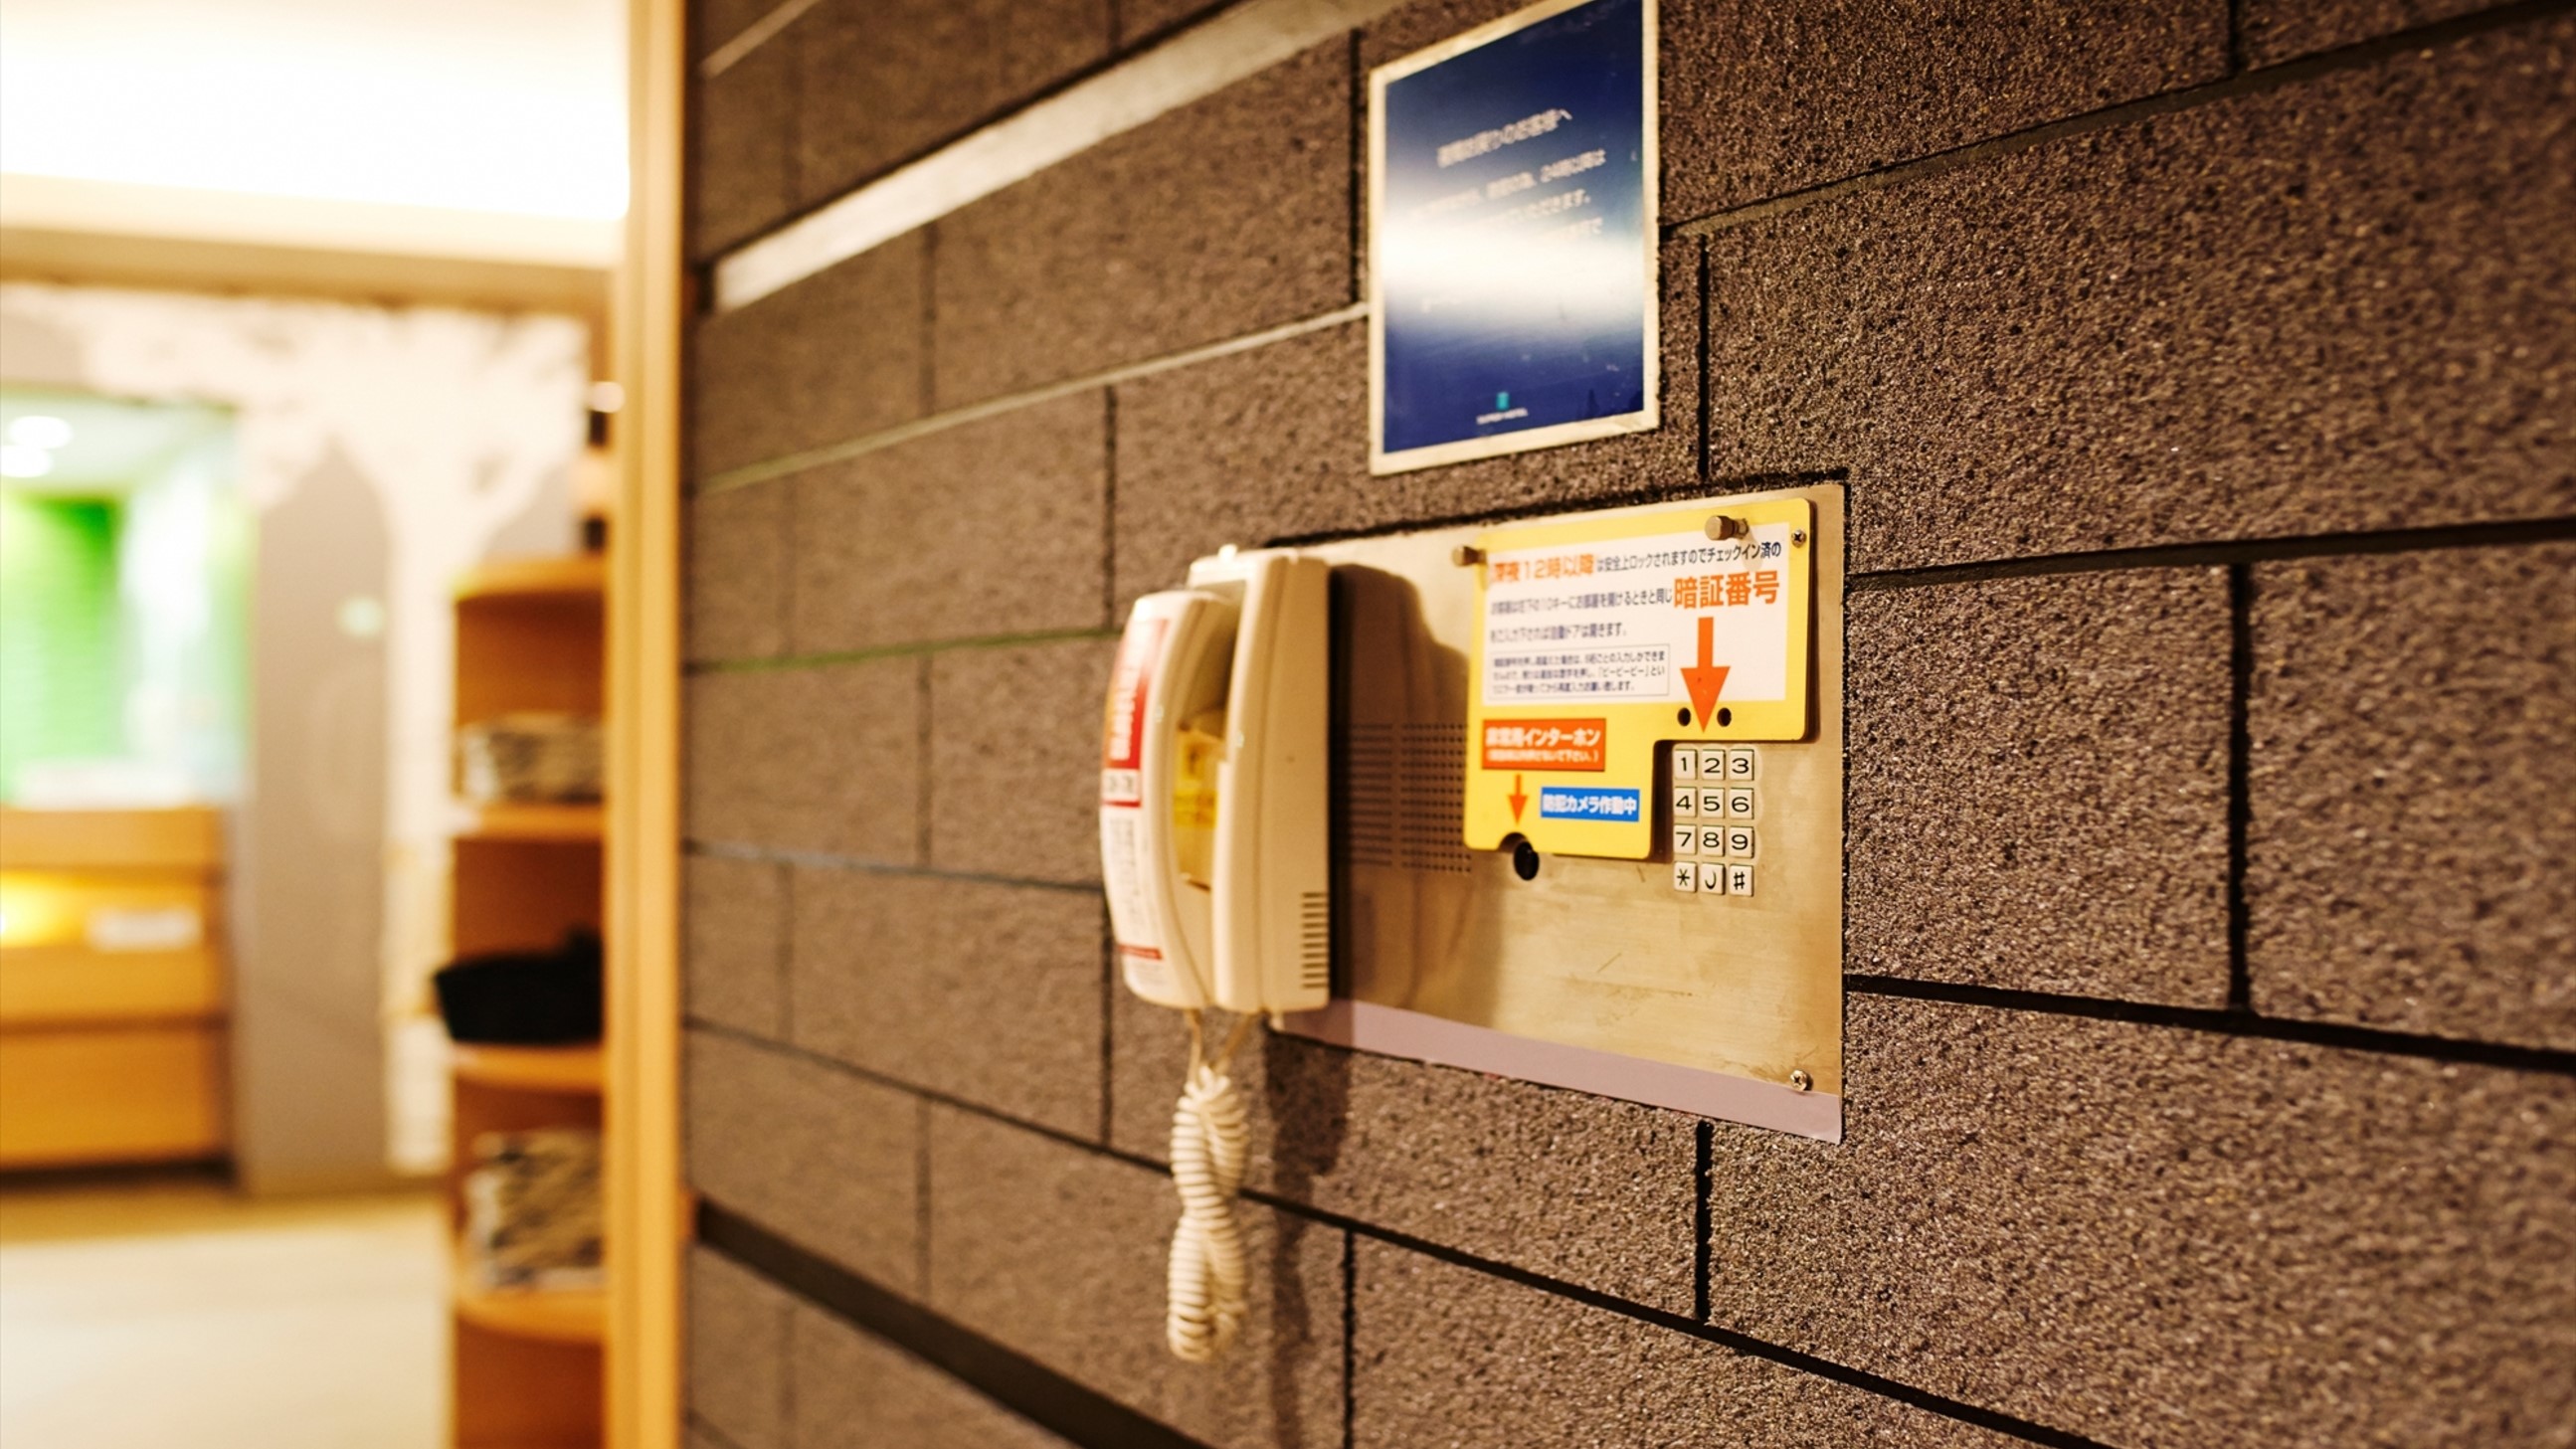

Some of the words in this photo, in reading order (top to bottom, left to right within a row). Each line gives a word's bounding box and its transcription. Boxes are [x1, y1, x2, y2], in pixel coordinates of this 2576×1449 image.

[1674, 570, 1780, 610] 暗証番号
[1485, 727, 1602, 748] インターホン
[1704, 757, 1721, 774] 2
[1732, 757, 1749, 775] 3
[1675, 795, 1692, 811] 4
[1703, 796, 1721, 813] 5
[1731, 796, 1750, 814] 6
[1675, 831, 1692, 847] 7
[1702, 831, 1721, 848] 8
[1731, 833, 1748, 851] 9
[1733, 871, 1746, 890] #
